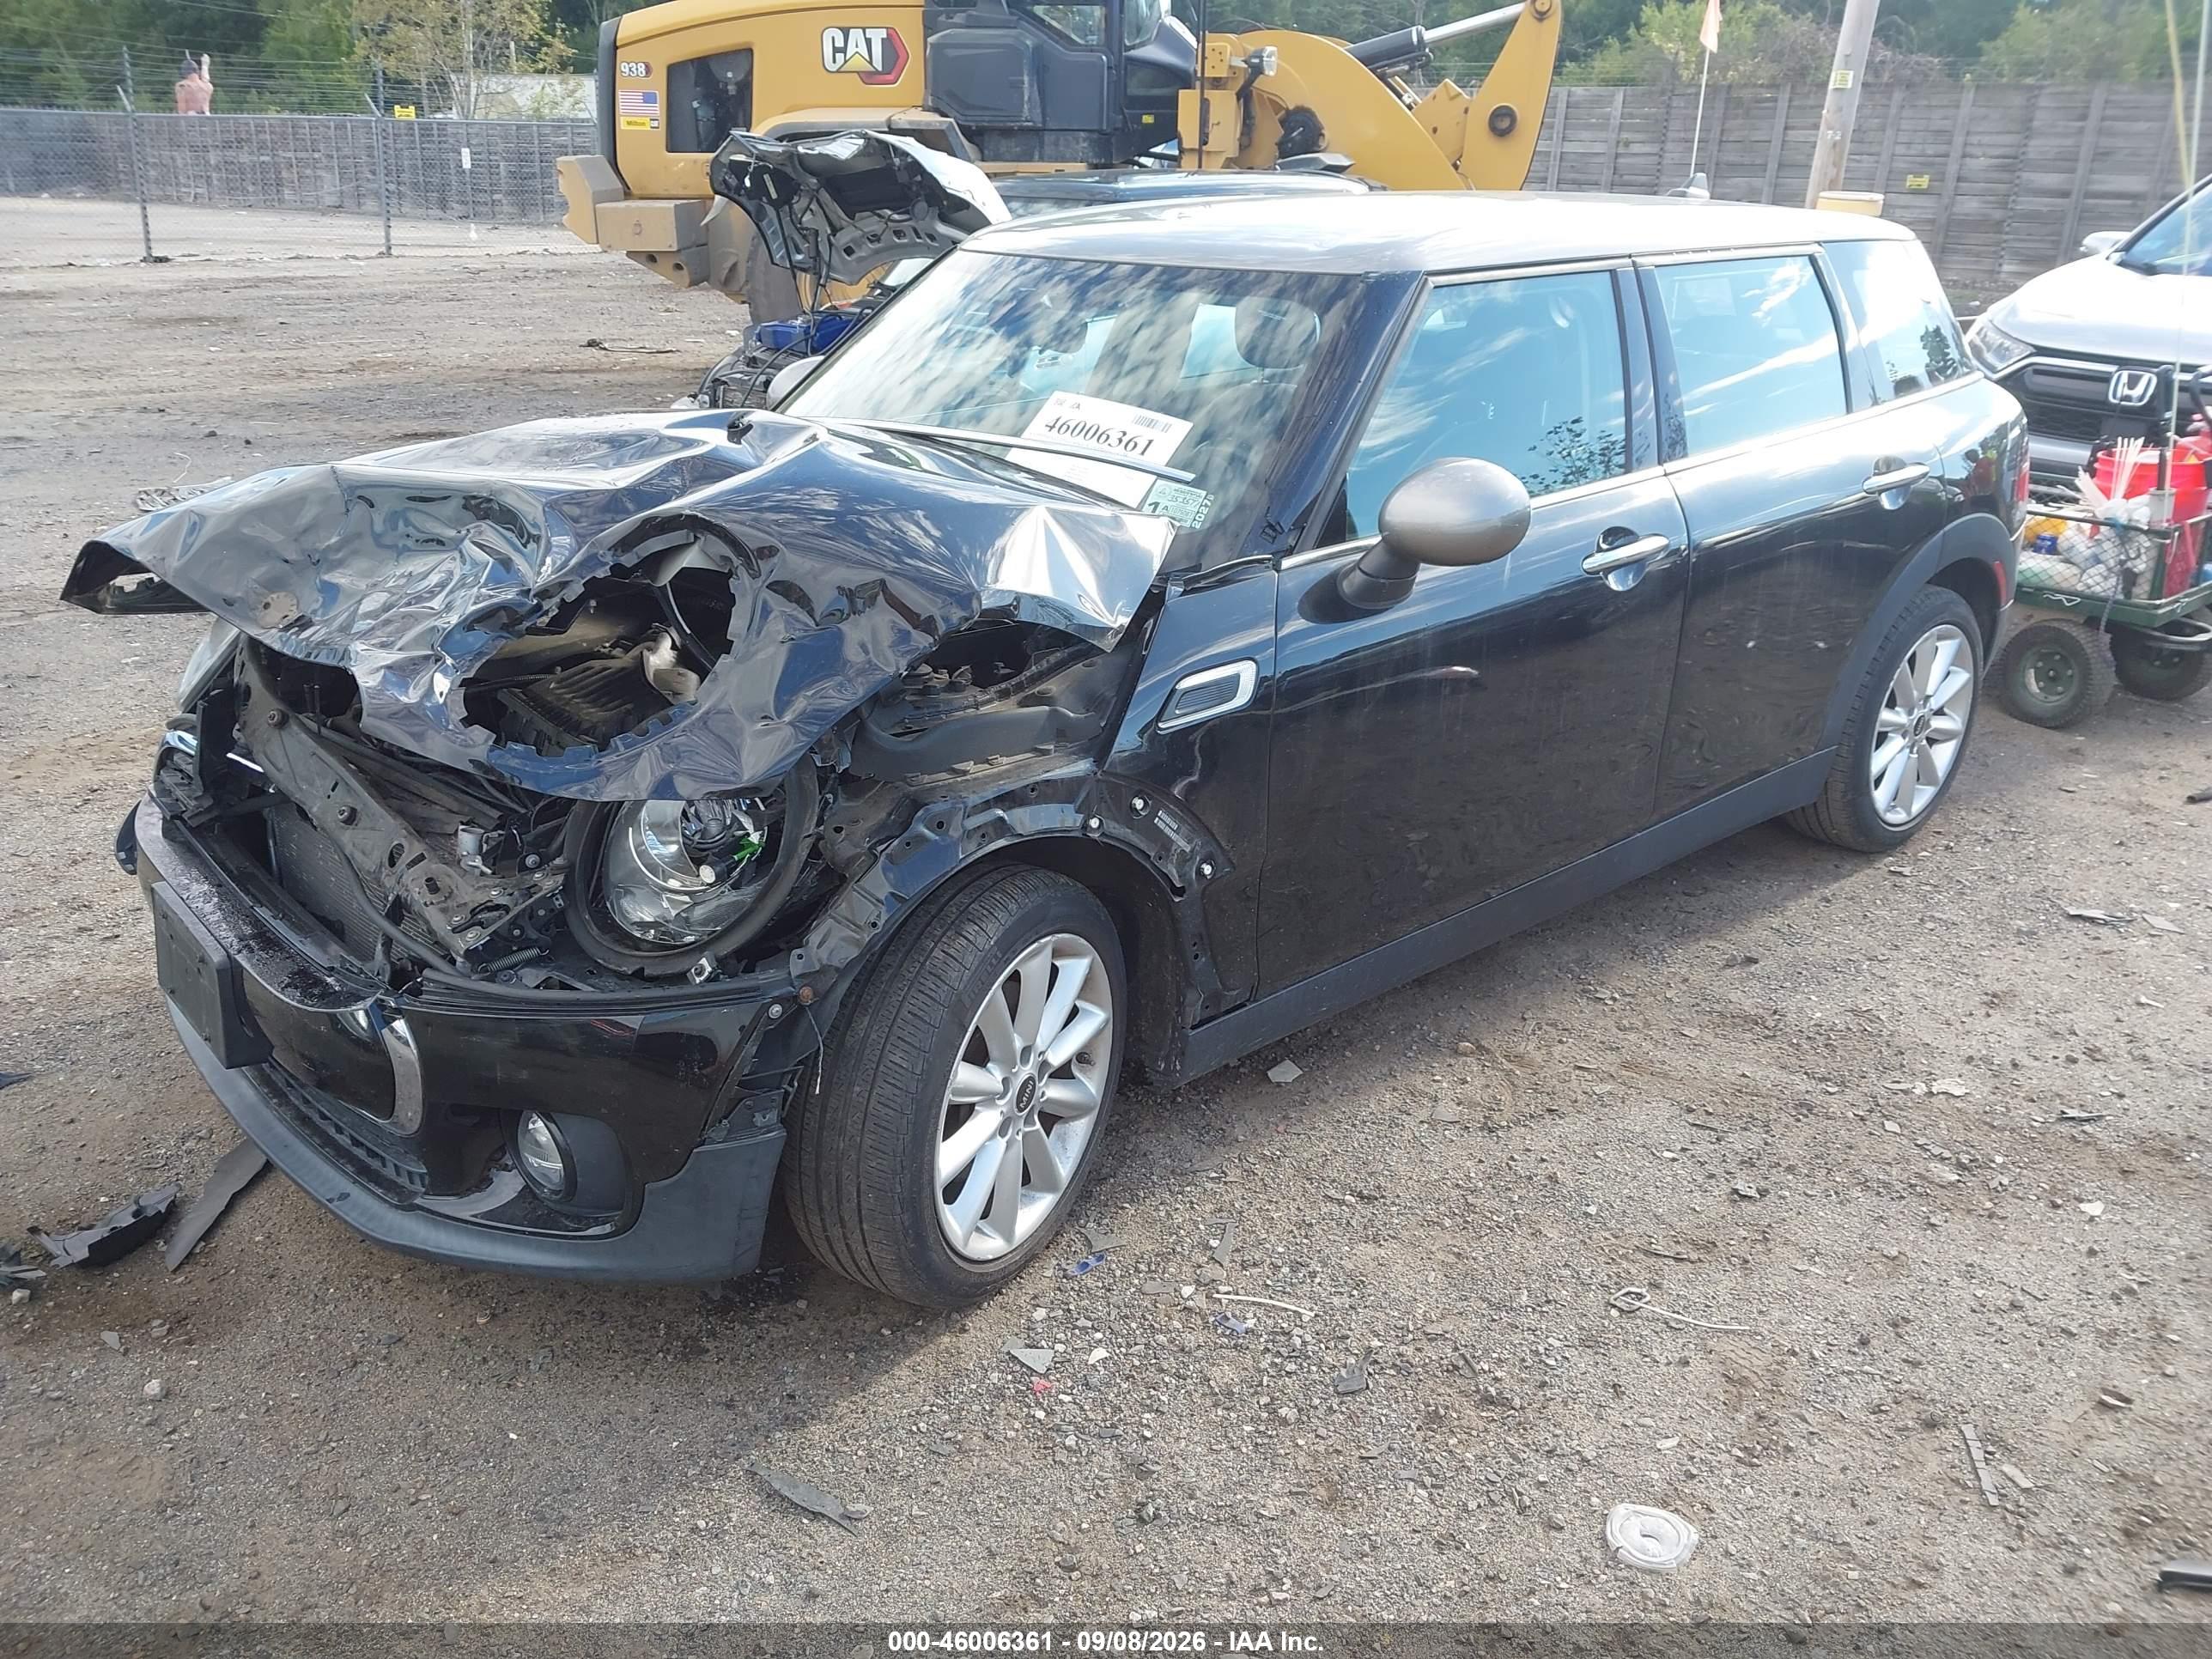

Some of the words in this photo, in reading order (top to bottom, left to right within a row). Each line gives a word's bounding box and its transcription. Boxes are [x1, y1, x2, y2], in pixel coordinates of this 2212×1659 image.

[822, 27, 888, 72] CAT
[620, 61, 646, 77] 938
[1044, 415, 1155, 457] 46006361
[1192, 501, 1212, 529] 2027
[1019, 1079, 1034, 1109] MINI
